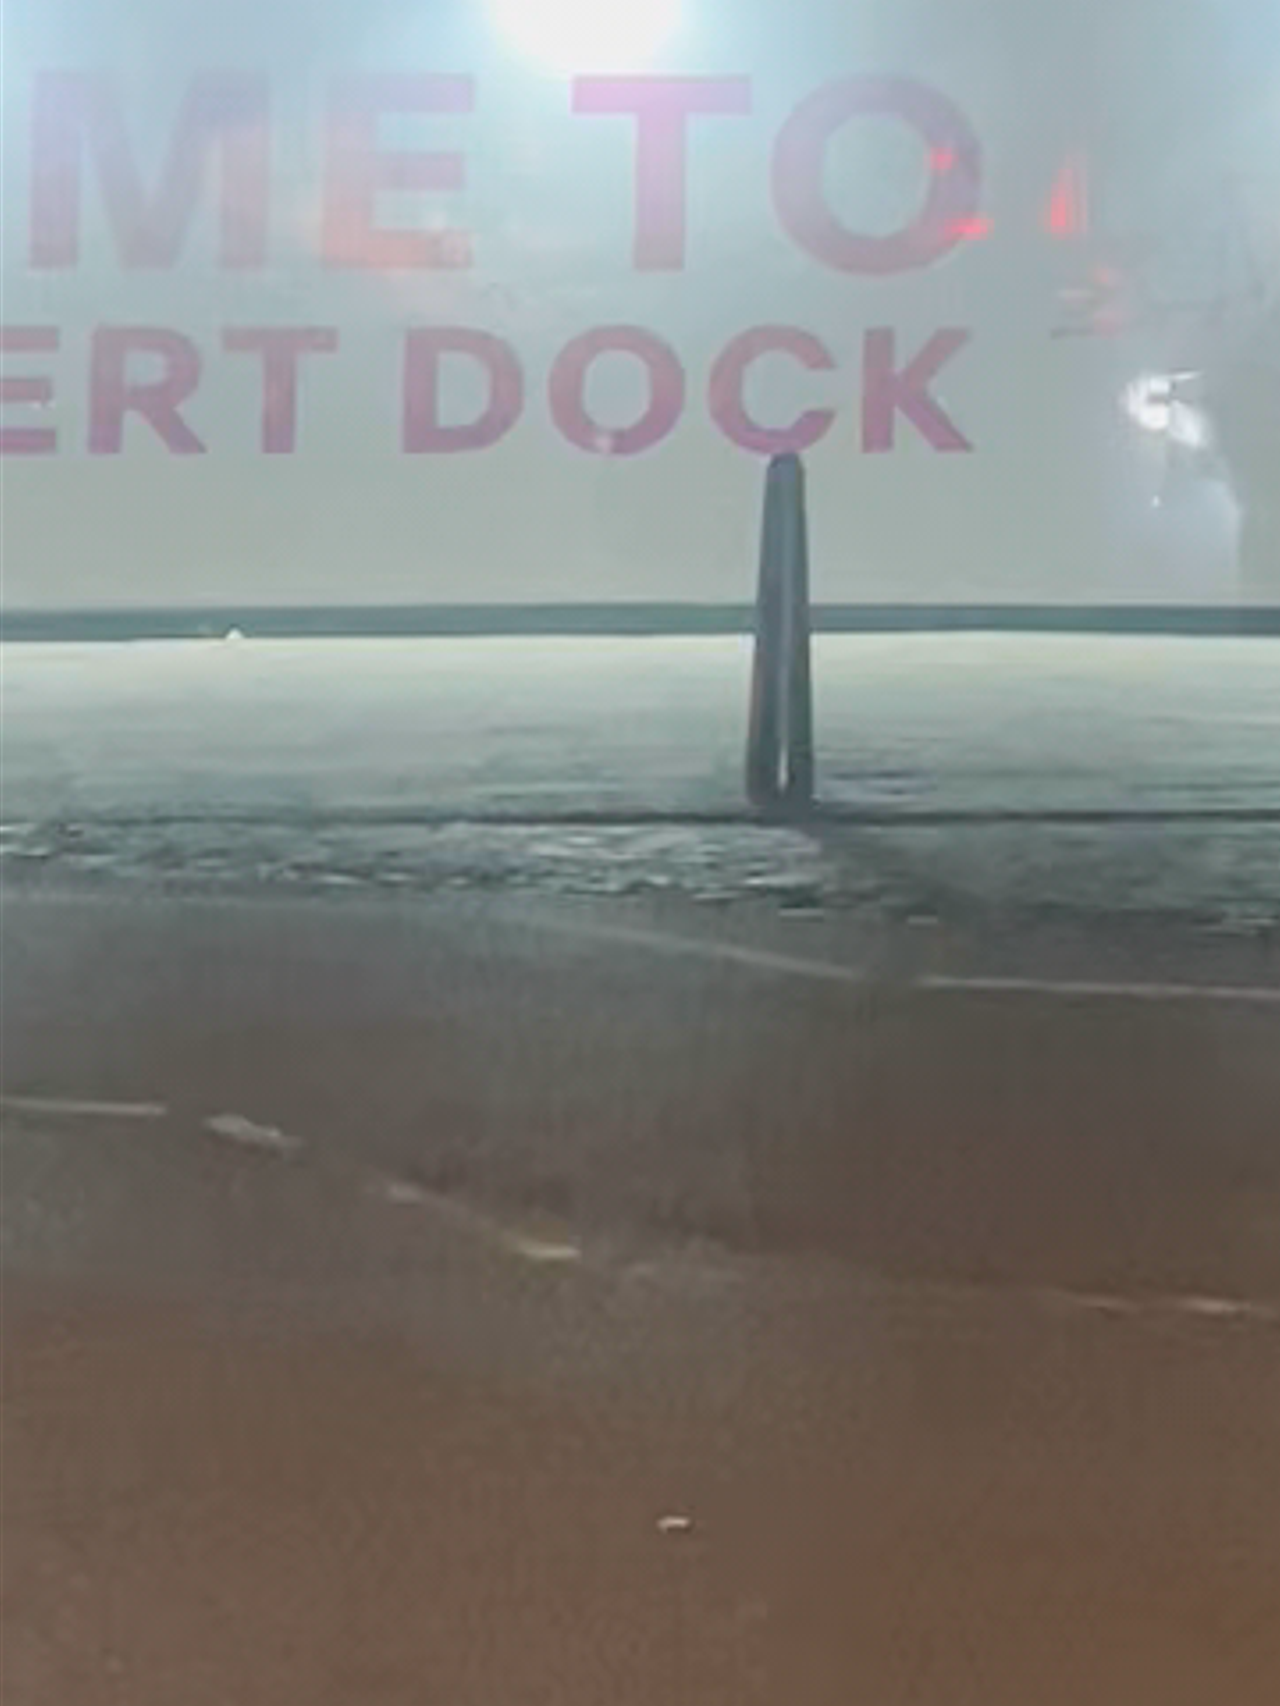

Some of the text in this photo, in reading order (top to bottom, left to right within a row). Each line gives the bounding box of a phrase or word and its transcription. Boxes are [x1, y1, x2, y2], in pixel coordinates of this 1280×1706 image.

[28, 71, 983, 275] ME TO
[401, 324, 974, 456] DOCK
